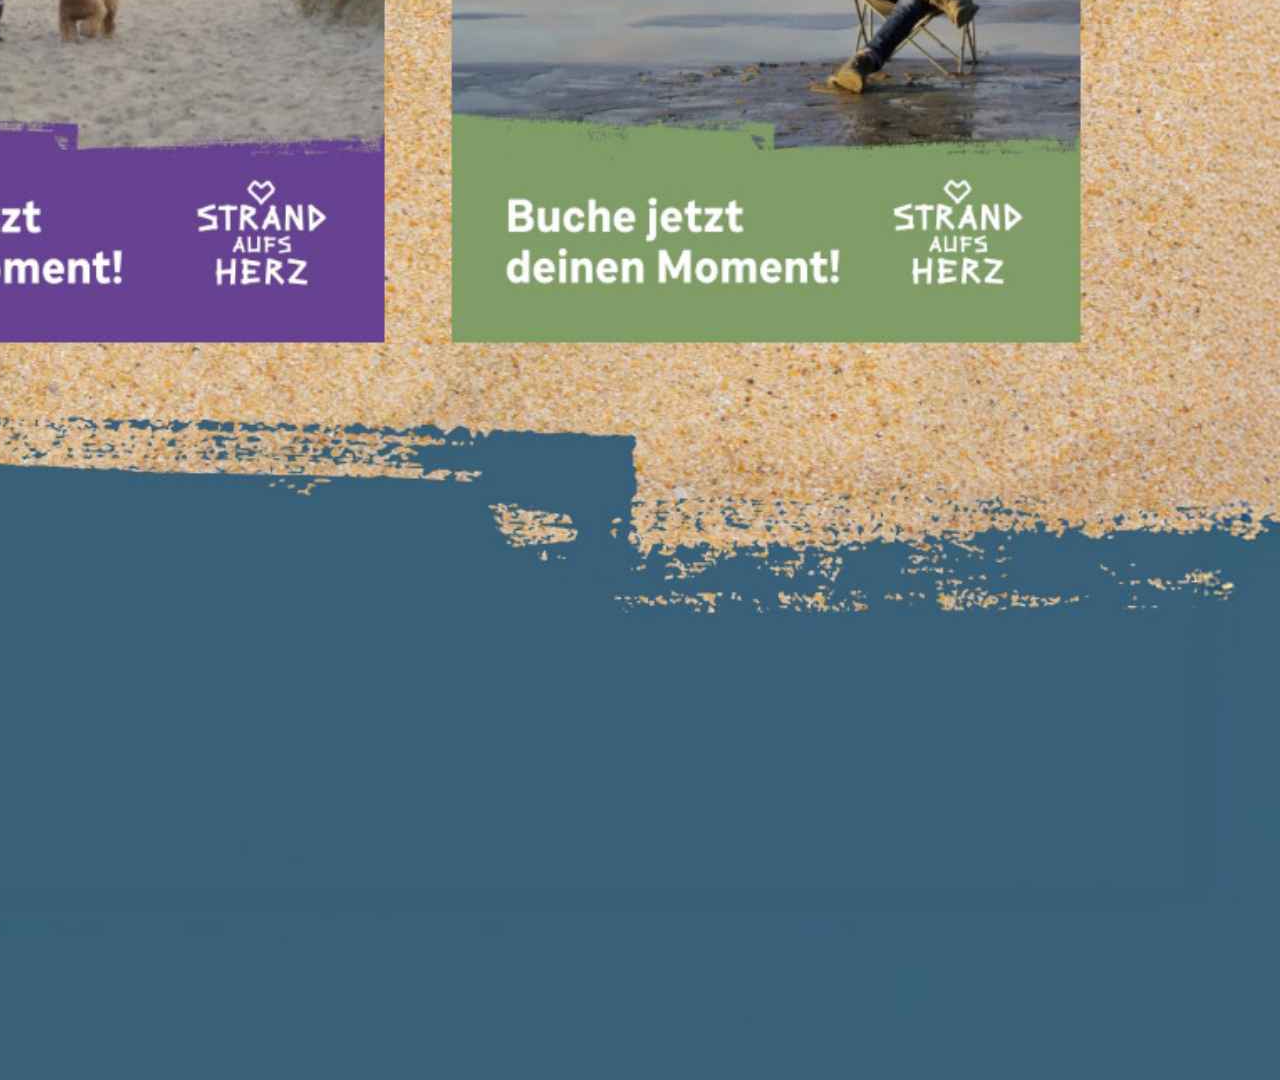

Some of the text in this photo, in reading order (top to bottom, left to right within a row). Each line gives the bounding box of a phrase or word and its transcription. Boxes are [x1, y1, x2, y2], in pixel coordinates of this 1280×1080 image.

[197, 204, 326, 231] STRAND
[508, 198, 743, 241] Buche jetzt
[894, 203, 1022, 230] STRAND
[233, 236, 291, 253] AUFS
[929, 236, 987, 253] AUFS
[216, 258, 307, 285] HERZ
[507, 248, 839, 284] deinen Moment!
[912, 258, 1003, 284] HERZ
